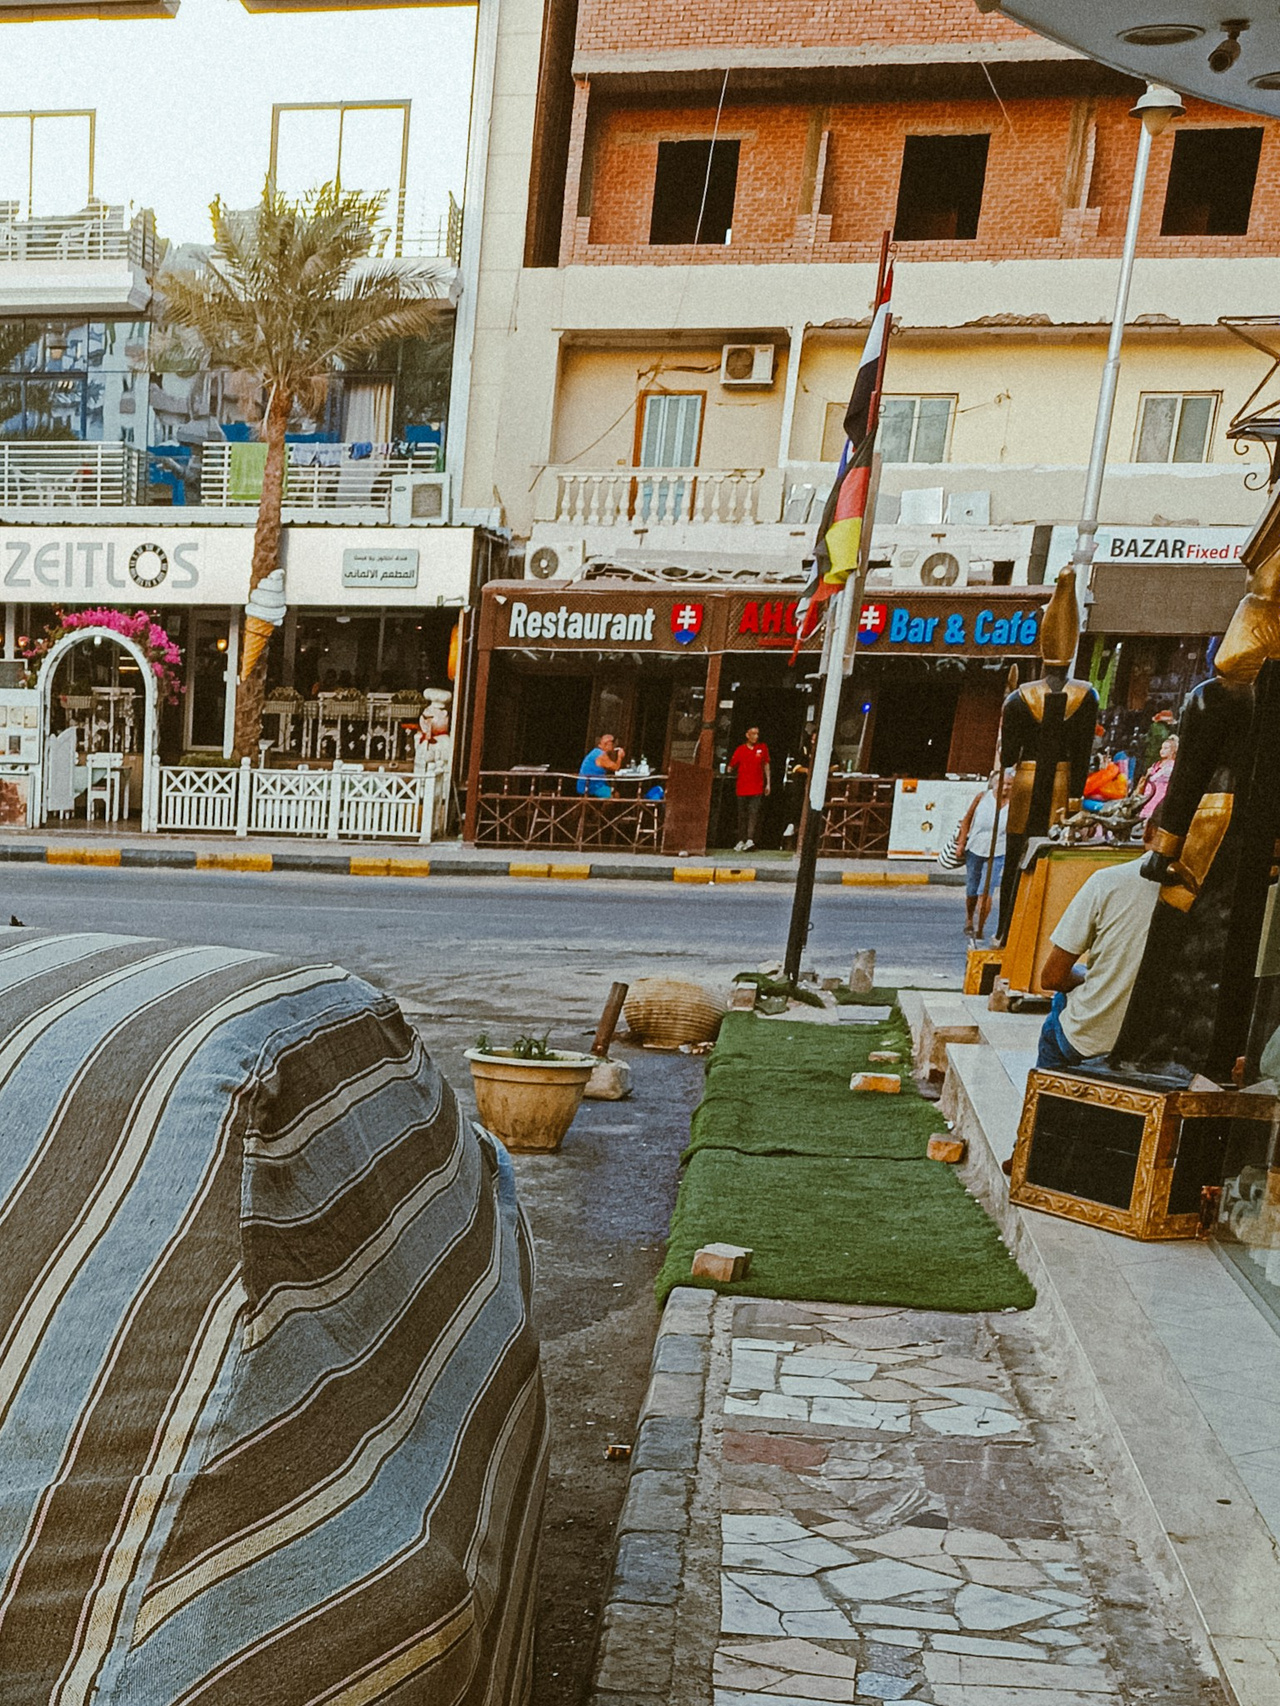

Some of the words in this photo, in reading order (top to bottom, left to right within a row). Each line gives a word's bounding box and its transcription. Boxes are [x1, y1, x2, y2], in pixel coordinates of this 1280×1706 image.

[4, 542, 200, 588] ZEITLOS
[1110, 538, 1186, 558] BAZAR
[1186, 544, 1230, 559] Fixed
[509, 602, 656, 641] Restaurant
[889, 608, 939, 644] Bar
[944, 613, 967, 645] &
[974, 609, 1039, 646] Café
